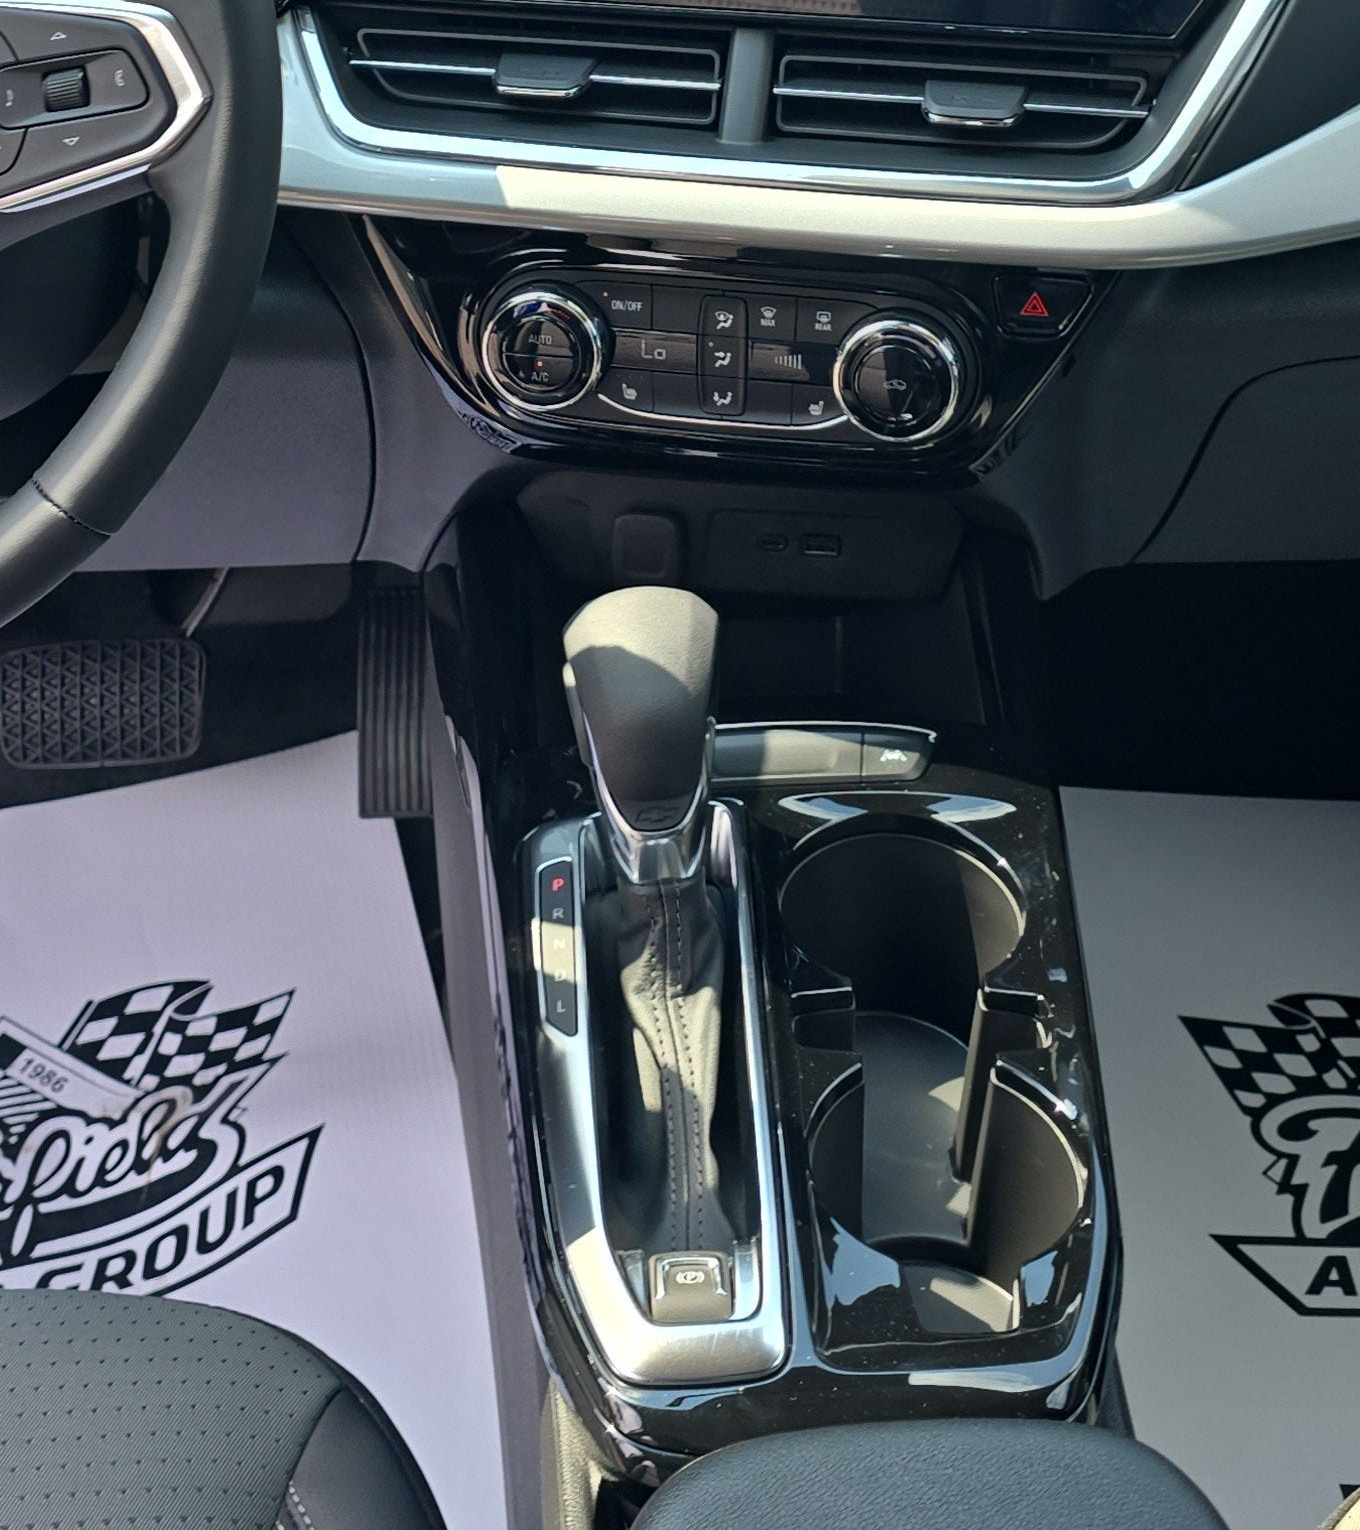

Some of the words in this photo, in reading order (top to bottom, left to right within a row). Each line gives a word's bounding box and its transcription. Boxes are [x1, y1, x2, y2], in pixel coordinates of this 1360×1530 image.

[610, 298, 643, 313] ON/OFF
[814, 322, 833, 332] REAR
[527, 332, 553, 346] AUTO
[531, 371, 549, 382] A/C
[551, 877, 565, 892] P
[552, 907, 565, 920] R
[552, 937, 566, 950] N
[555, 999, 567, 1014] L
[19, 1055, 68, 1095] 1986
